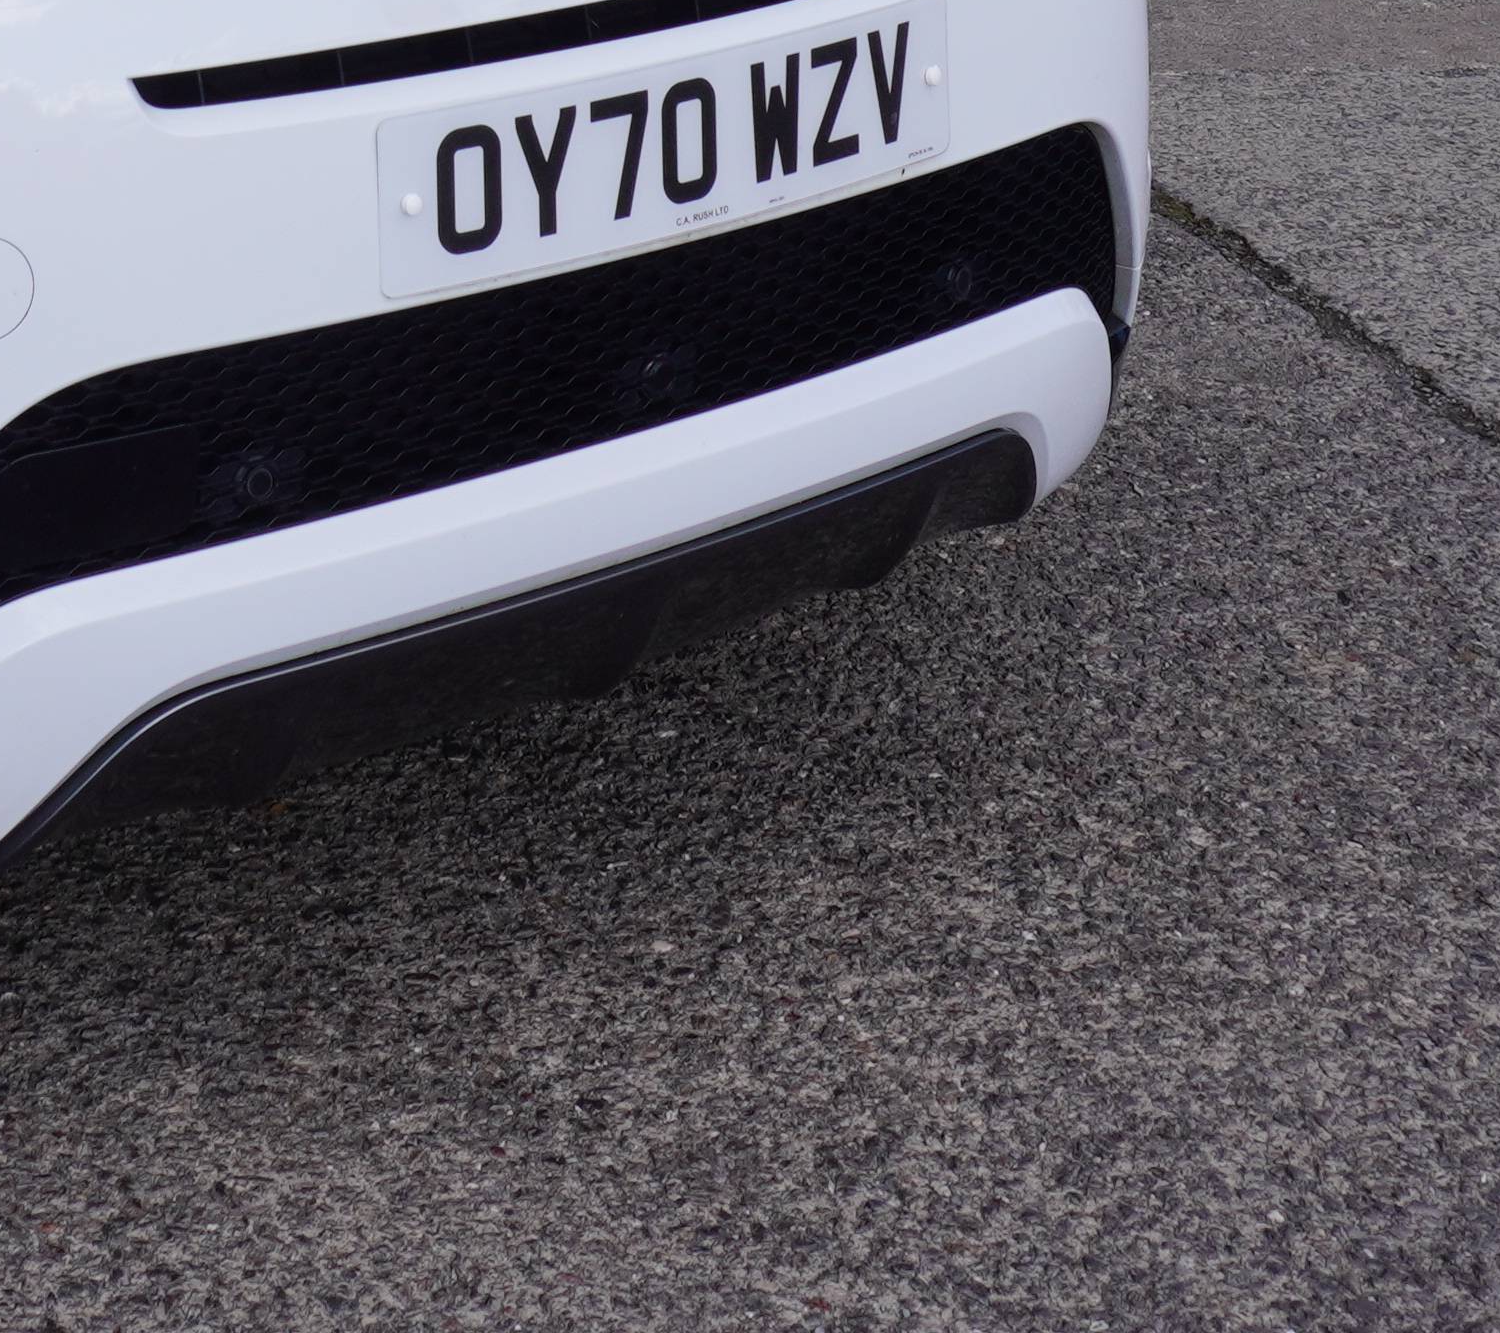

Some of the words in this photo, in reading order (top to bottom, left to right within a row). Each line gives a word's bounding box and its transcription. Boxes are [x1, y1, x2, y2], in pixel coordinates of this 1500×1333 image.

[436, 76, 718, 256] OY70
[749, 20, 911, 184] WZV
[692, 209, 715, 222] RUSH
